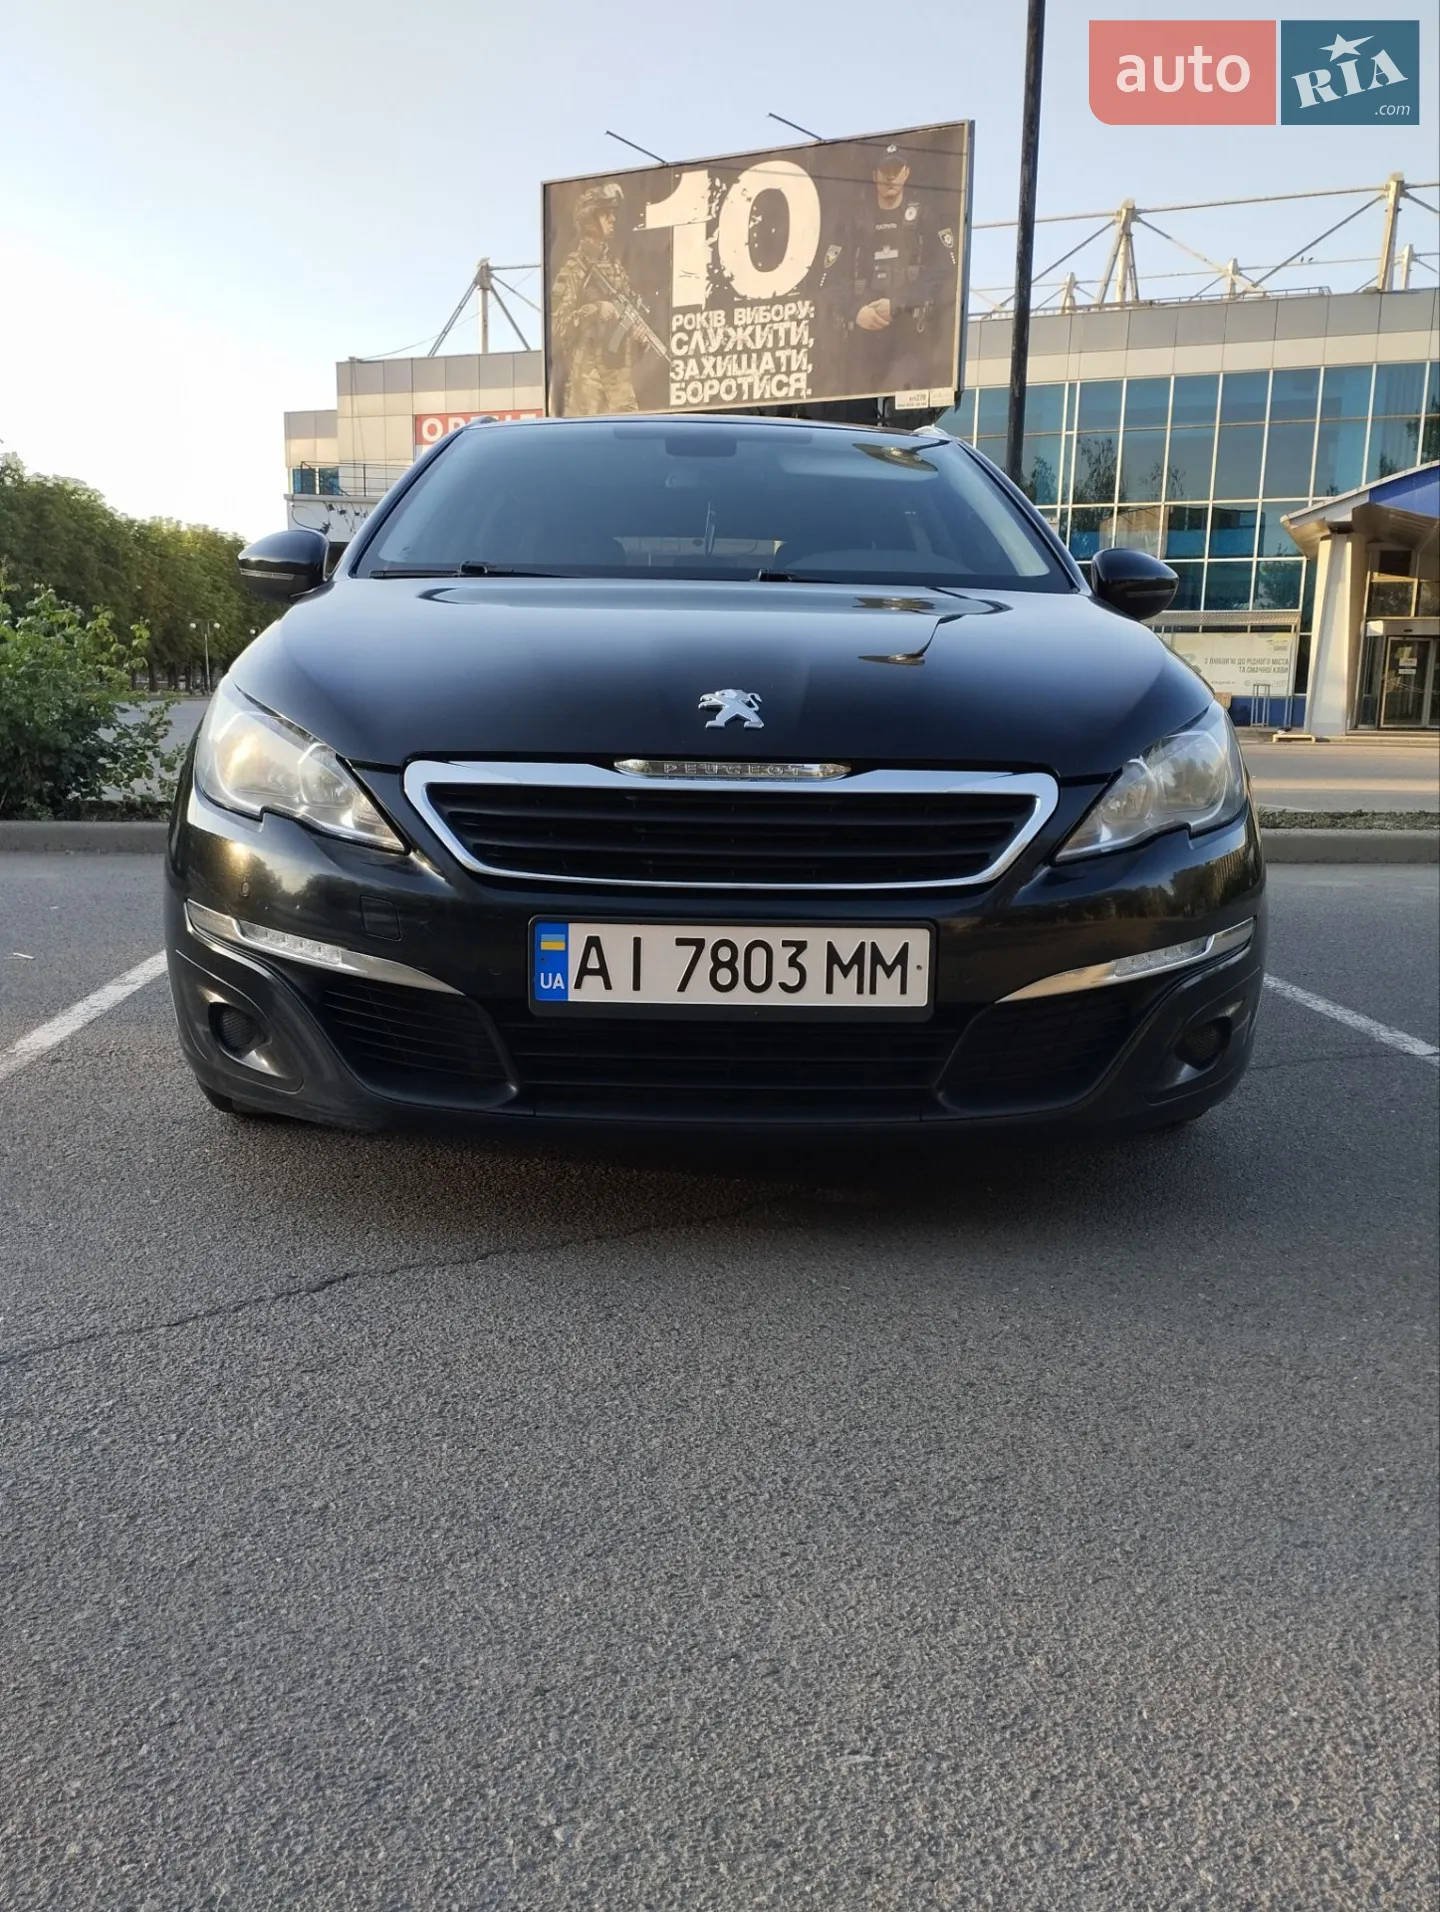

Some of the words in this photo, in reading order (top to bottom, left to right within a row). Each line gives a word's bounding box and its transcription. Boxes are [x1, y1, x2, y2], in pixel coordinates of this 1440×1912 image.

[633, 160, 821, 308] 10
[671, 310, 726, 332] РОКІВ
[733, 300, 815, 325] ВИБОРУ:
[670, 320, 815, 356] СЛУЖИТИ,
[670, 349, 813, 381] ЗАХИЩАТИ,
[669, 372, 812, 406] БОРОТИСЯ.
[663, 762, 805, 777] PEUGEOT
[540, 973, 565, 989] UA
[573, 935, 642, 991] AI
[675, 938, 808, 993] 7803
[825, 940, 909, 995] MM
